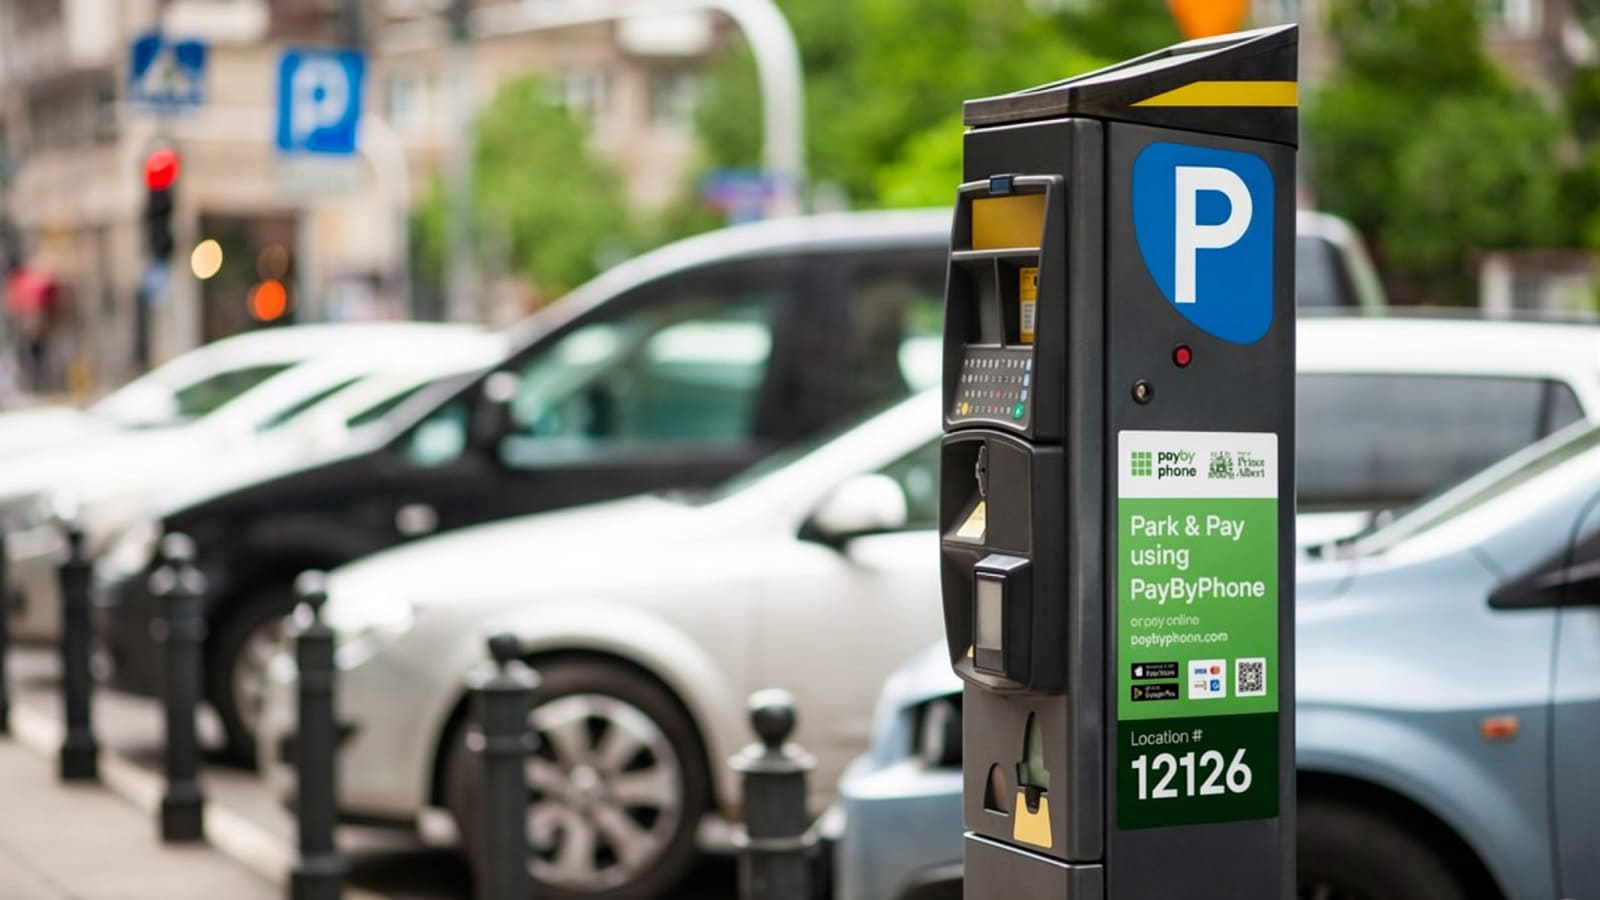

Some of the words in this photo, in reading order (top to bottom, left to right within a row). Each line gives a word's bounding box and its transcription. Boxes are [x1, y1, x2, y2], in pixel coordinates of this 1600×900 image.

[290, 57, 350, 147] P
[1175, 166, 1253, 303] P
[1158, 464, 1197, 480] phone
[1131, 515, 1179, 536] Park
[1185, 515, 1200, 536] &
[1206, 515, 1245, 541] Pay
[1130, 544, 1189, 570] using
[1130, 577, 1265, 605] PayByPhone
[1131, 730, 1189, 746] Location
[1192, 729, 1203, 742] #
[1131, 748, 1252, 800] 12126
